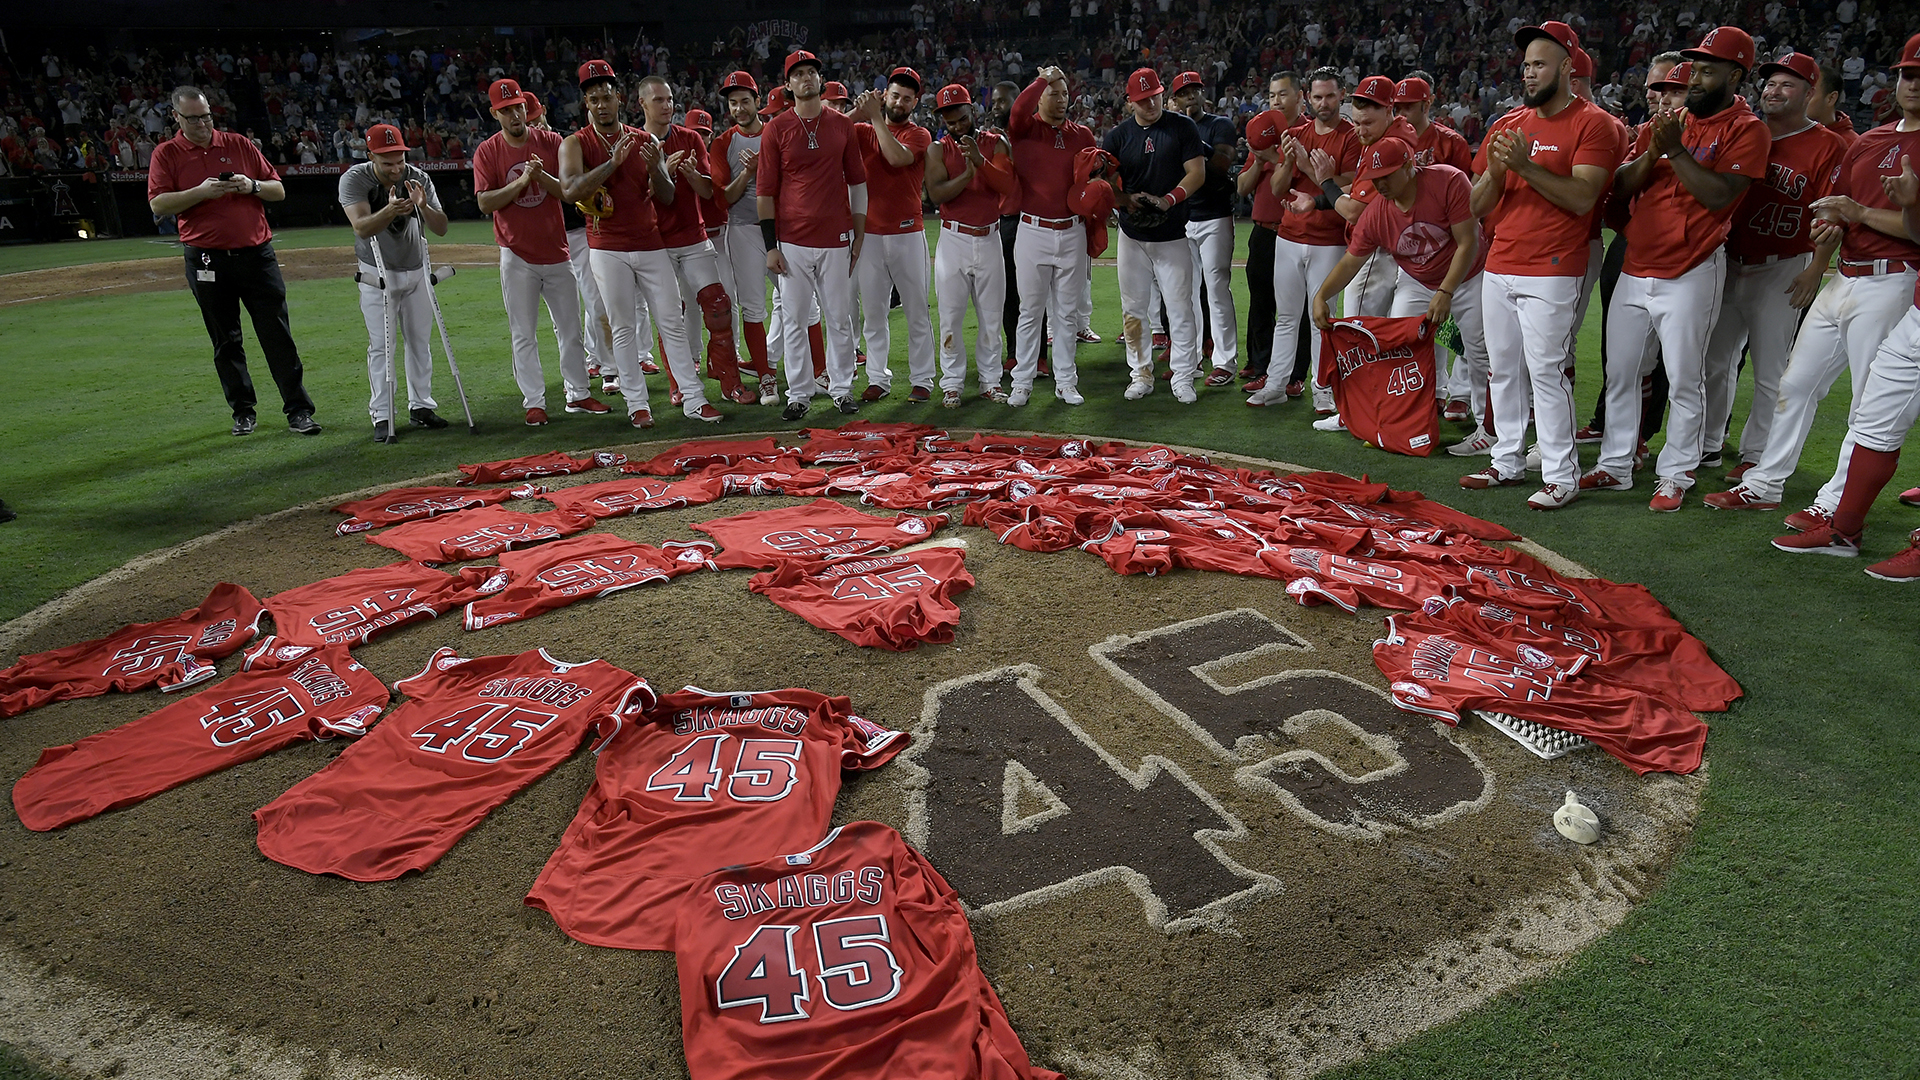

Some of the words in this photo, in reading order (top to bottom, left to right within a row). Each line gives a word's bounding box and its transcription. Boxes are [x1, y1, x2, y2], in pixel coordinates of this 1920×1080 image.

[745, 19, 809, 48] ANGELS
[111, 172, 134, 182] State
[134, 172, 149, 181] Far
[298, 165, 320, 175] State
[320, 165, 340, 174] Farm
[418, 162, 438, 171] State
[439, 161, 458, 170] Farm
[1763, 162, 1808, 201] ELS
[1748, 201, 1803, 239] 45
[1386, 361, 1425, 396] 45
[761, 526, 859, 551] 45
[535, 553, 640, 589] 45
[831, 563, 942, 600] 45
[308, 587, 418, 636] 45
[102, 634, 193, 677] 45
[287, 657, 353, 706] SKAGGS
[478, 676, 593, 709] SKAGGS
[1463, 648, 1553, 702] 45
[199, 686, 306, 748] 45
[409, 702, 560, 764] 45
[673, 704, 811, 736] SKAGGS
[645, 733, 804, 802] 45
[901, 608, 1497, 936] 45
[715, 865, 886, 921] SKAGGS
[716, 914, 905, 1025] 45
